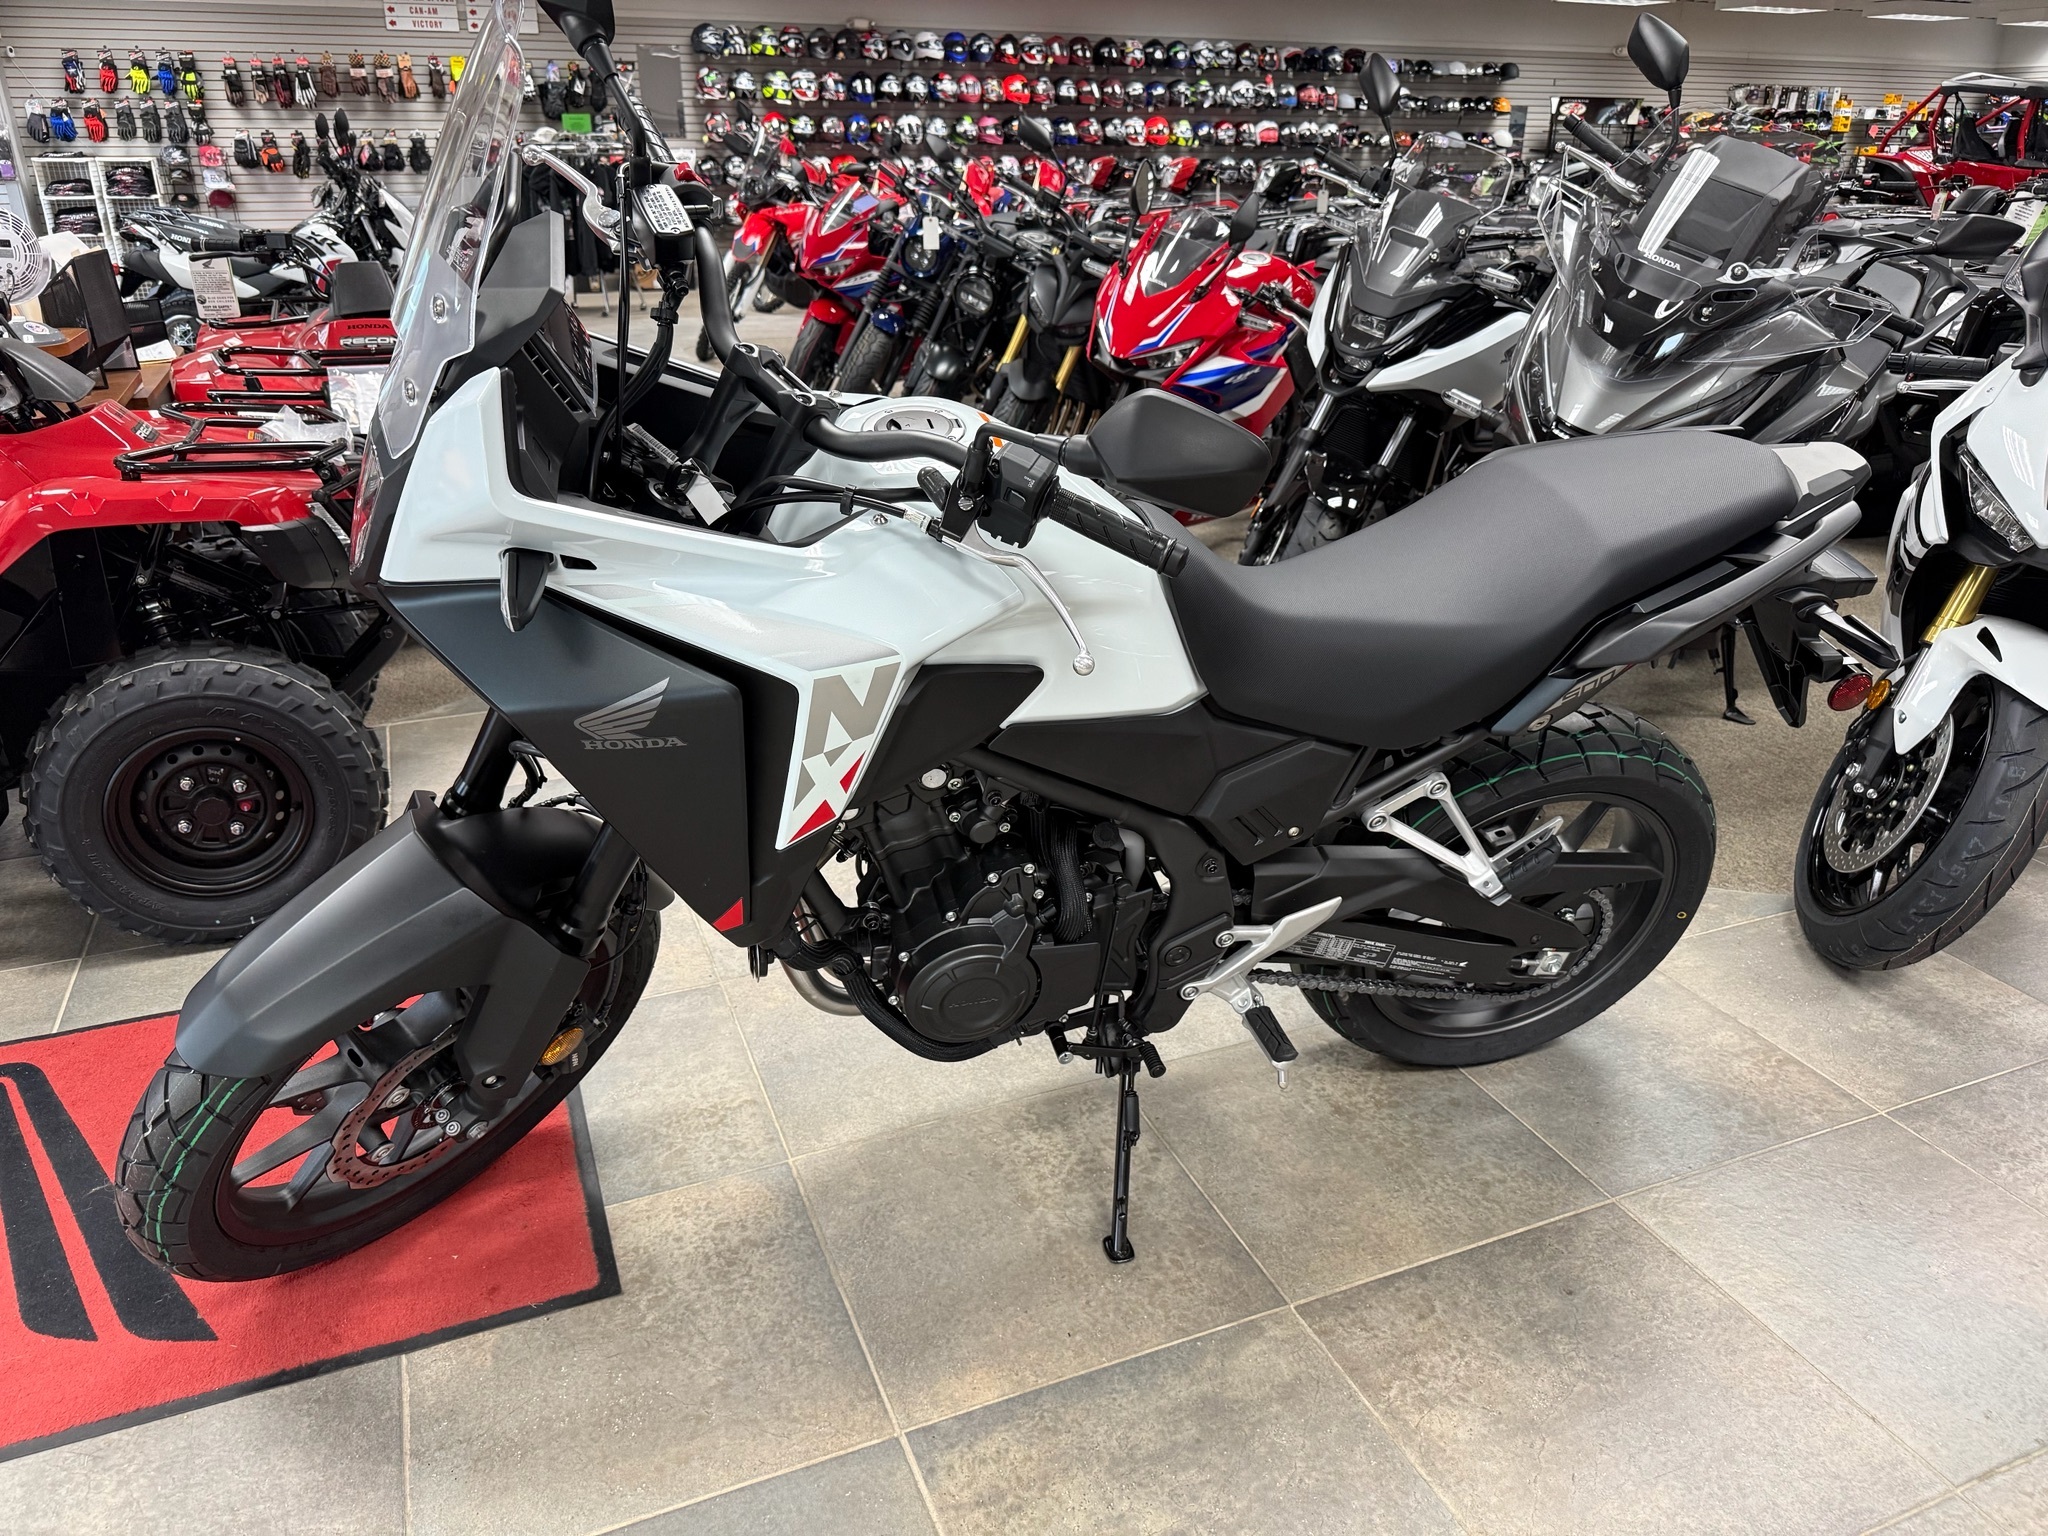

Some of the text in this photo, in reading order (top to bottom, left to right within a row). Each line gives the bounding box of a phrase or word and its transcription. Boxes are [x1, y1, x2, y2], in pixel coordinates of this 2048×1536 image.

[409, 6, 438, 15] CAN-AM
[412, 20, 442, 28] VICTORY
[1643, 251, 1681, 271] HONDA
[581, 736, 688, 750] HONDA
[786, 661, 902, 846] NX
